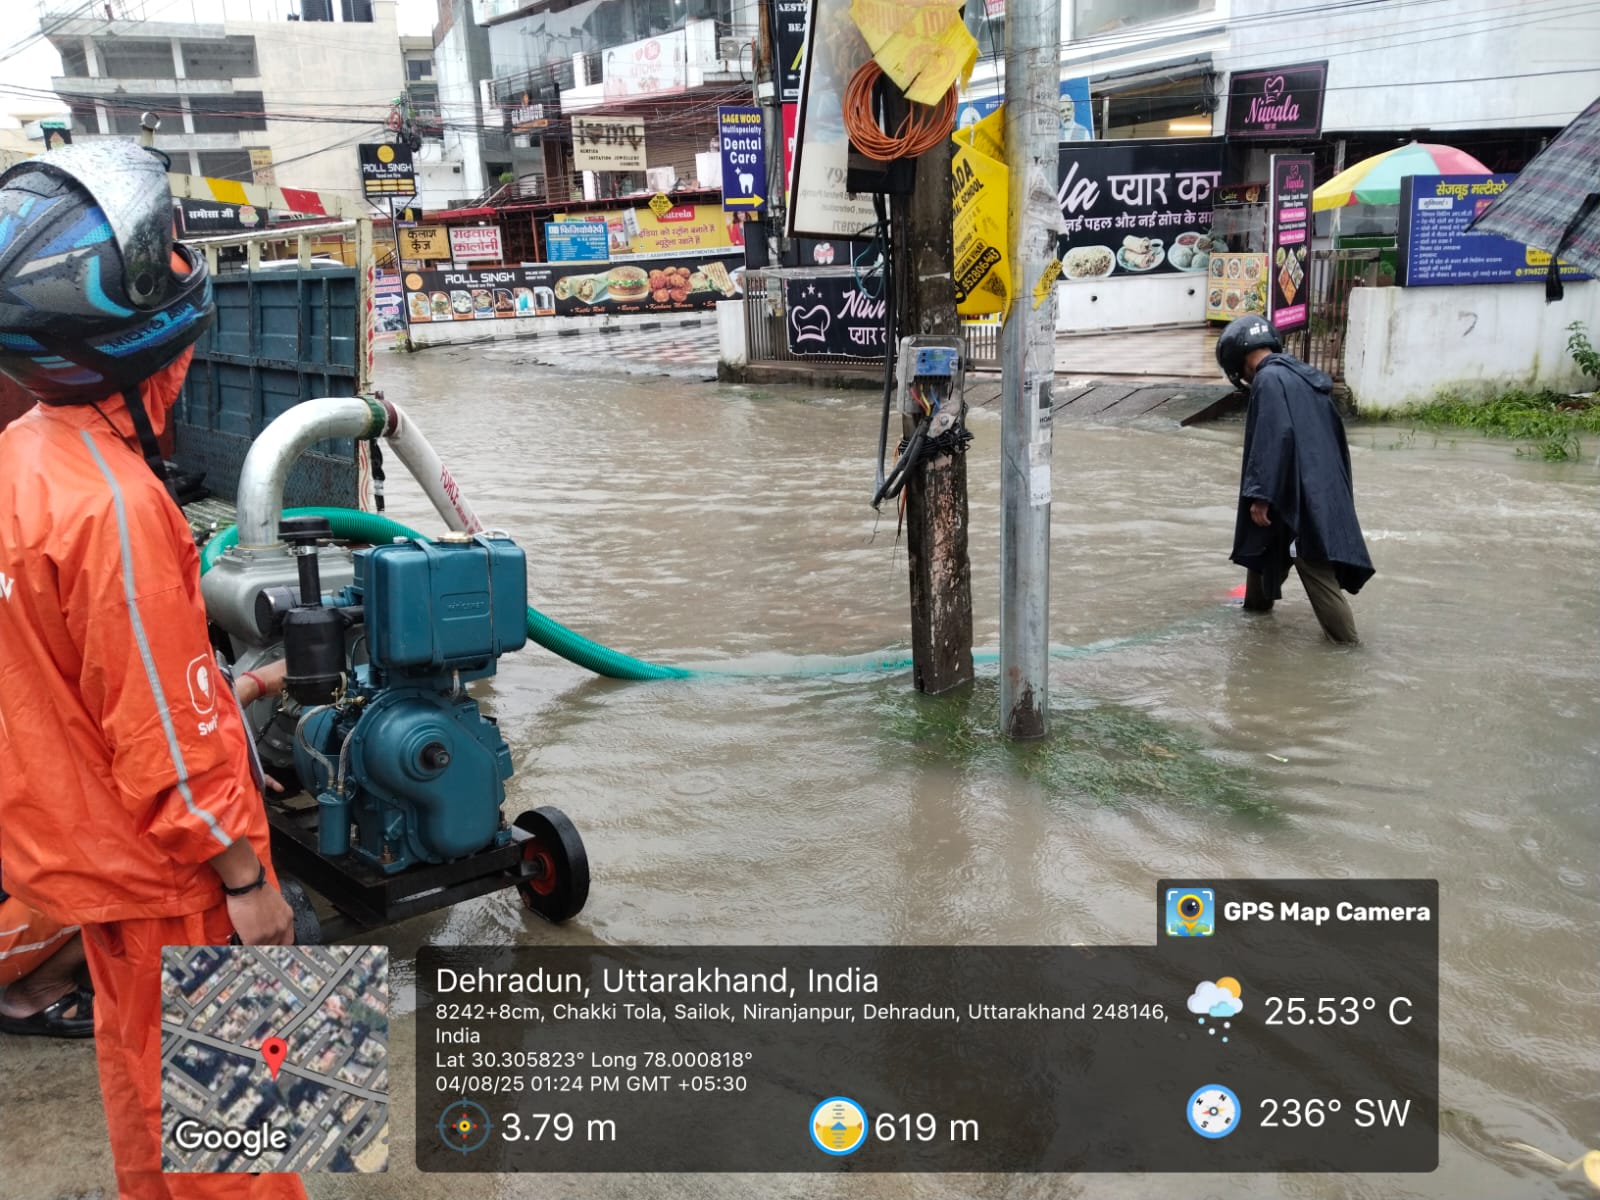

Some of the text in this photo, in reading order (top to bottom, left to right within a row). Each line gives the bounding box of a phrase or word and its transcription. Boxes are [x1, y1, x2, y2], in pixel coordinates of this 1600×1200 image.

[1244, 94, 1300, 123] Niwala
[722, 114, 761, 124] SAGE WOOD
[724, 137, 761, 150] Dental
[730, 152, 757, 164] Care
[363, 163, 412, 173] ROLL SINGH
[961, 178, 984, 209] SCHOOL
[1107, 173, 1171, 206] प्यार
[188, 207, 234, 219] समोसा जी
[1085, 217, 1112, 231] पहल
[1115, 211, 1136, 228] और
[1138, 209, 1157, 227] नई
[1158, 210, 1182, 226] सोच
[1183, 208, 1196, 225] के
[444, 273, 478, 285] ROLL
[480, 271, 516, 283] SINGH
[848, 327, 878, 345] प्यार
